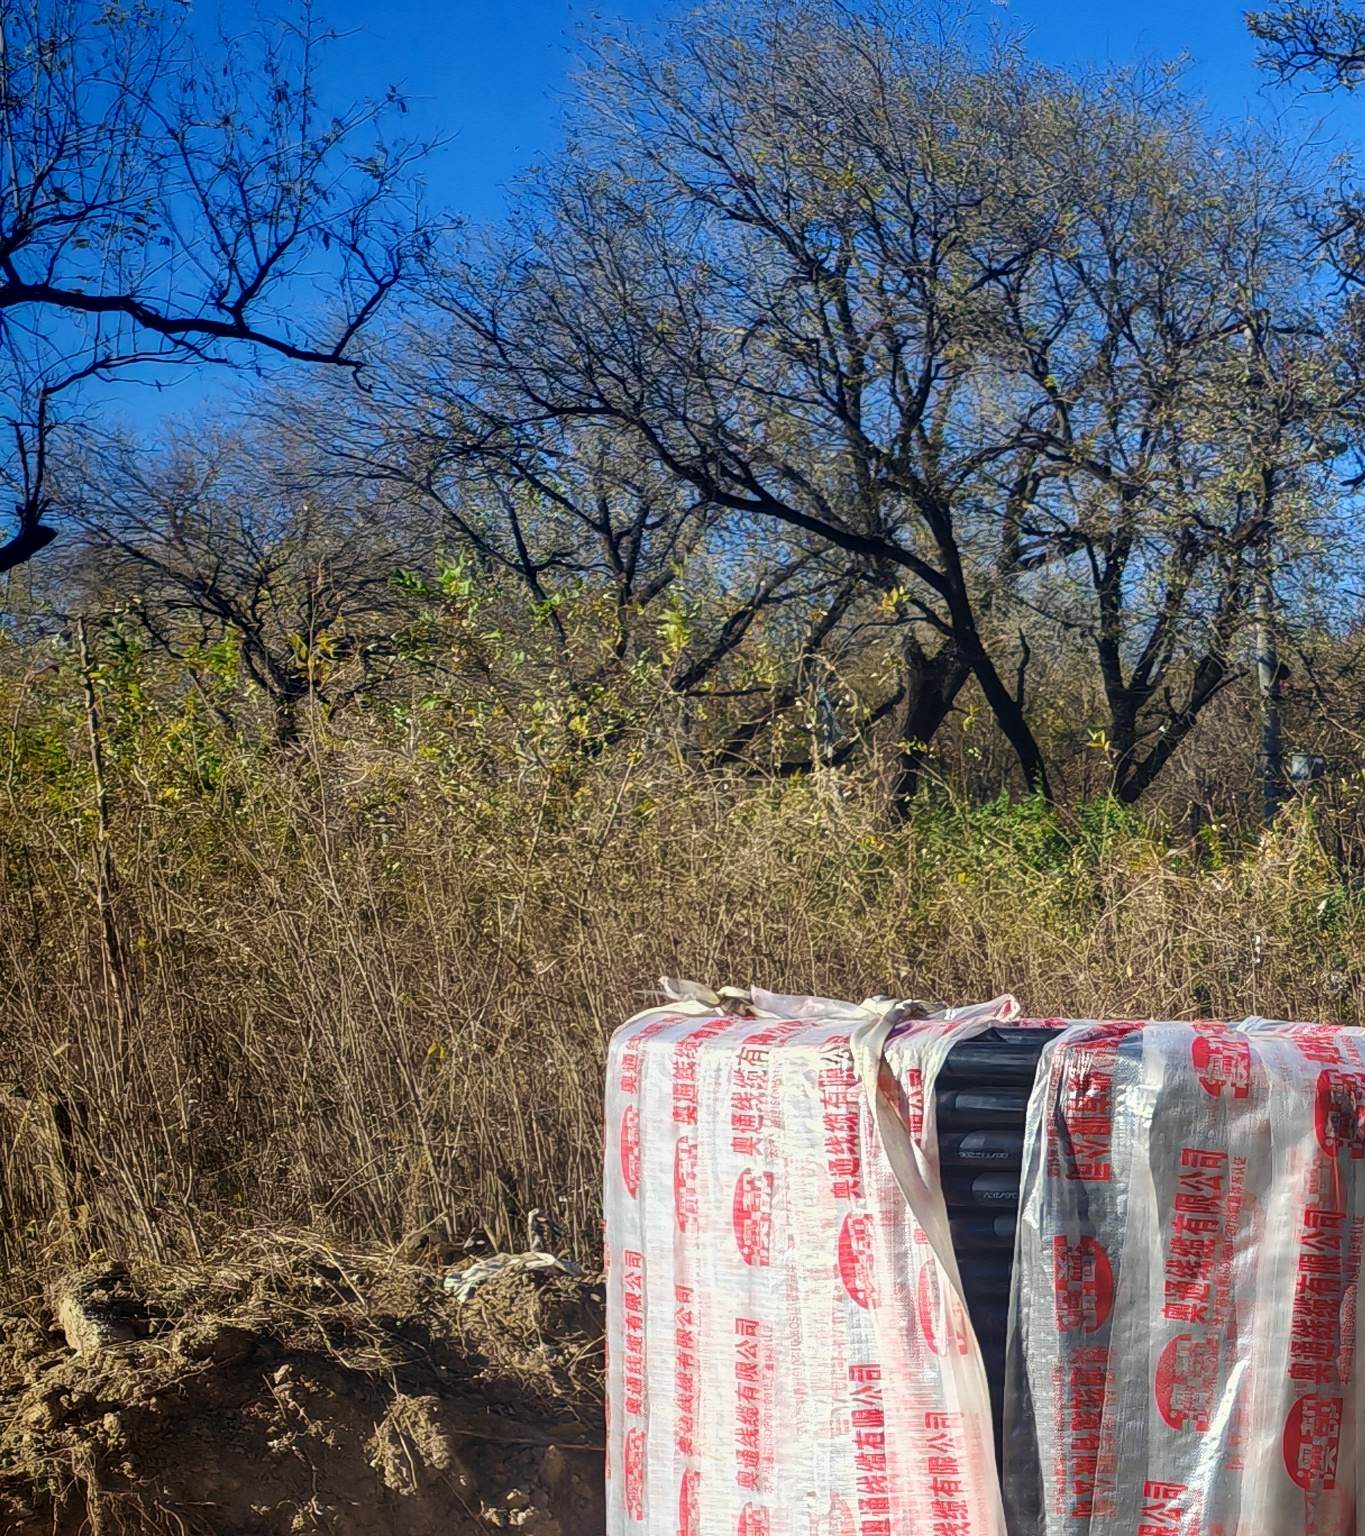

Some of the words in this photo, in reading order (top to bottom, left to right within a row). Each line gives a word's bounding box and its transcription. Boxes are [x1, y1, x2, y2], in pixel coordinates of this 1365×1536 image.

[1160, 1147, 1228, 1324] 奥通线缆有限公司
[1287, 1208, 1346, 1385] 奥通线缆有限公司
[622, 1250, 643, 1416] 奥通线缆有限公司
[734, 1317, 760, 1492] 奥通线缆有限公司
